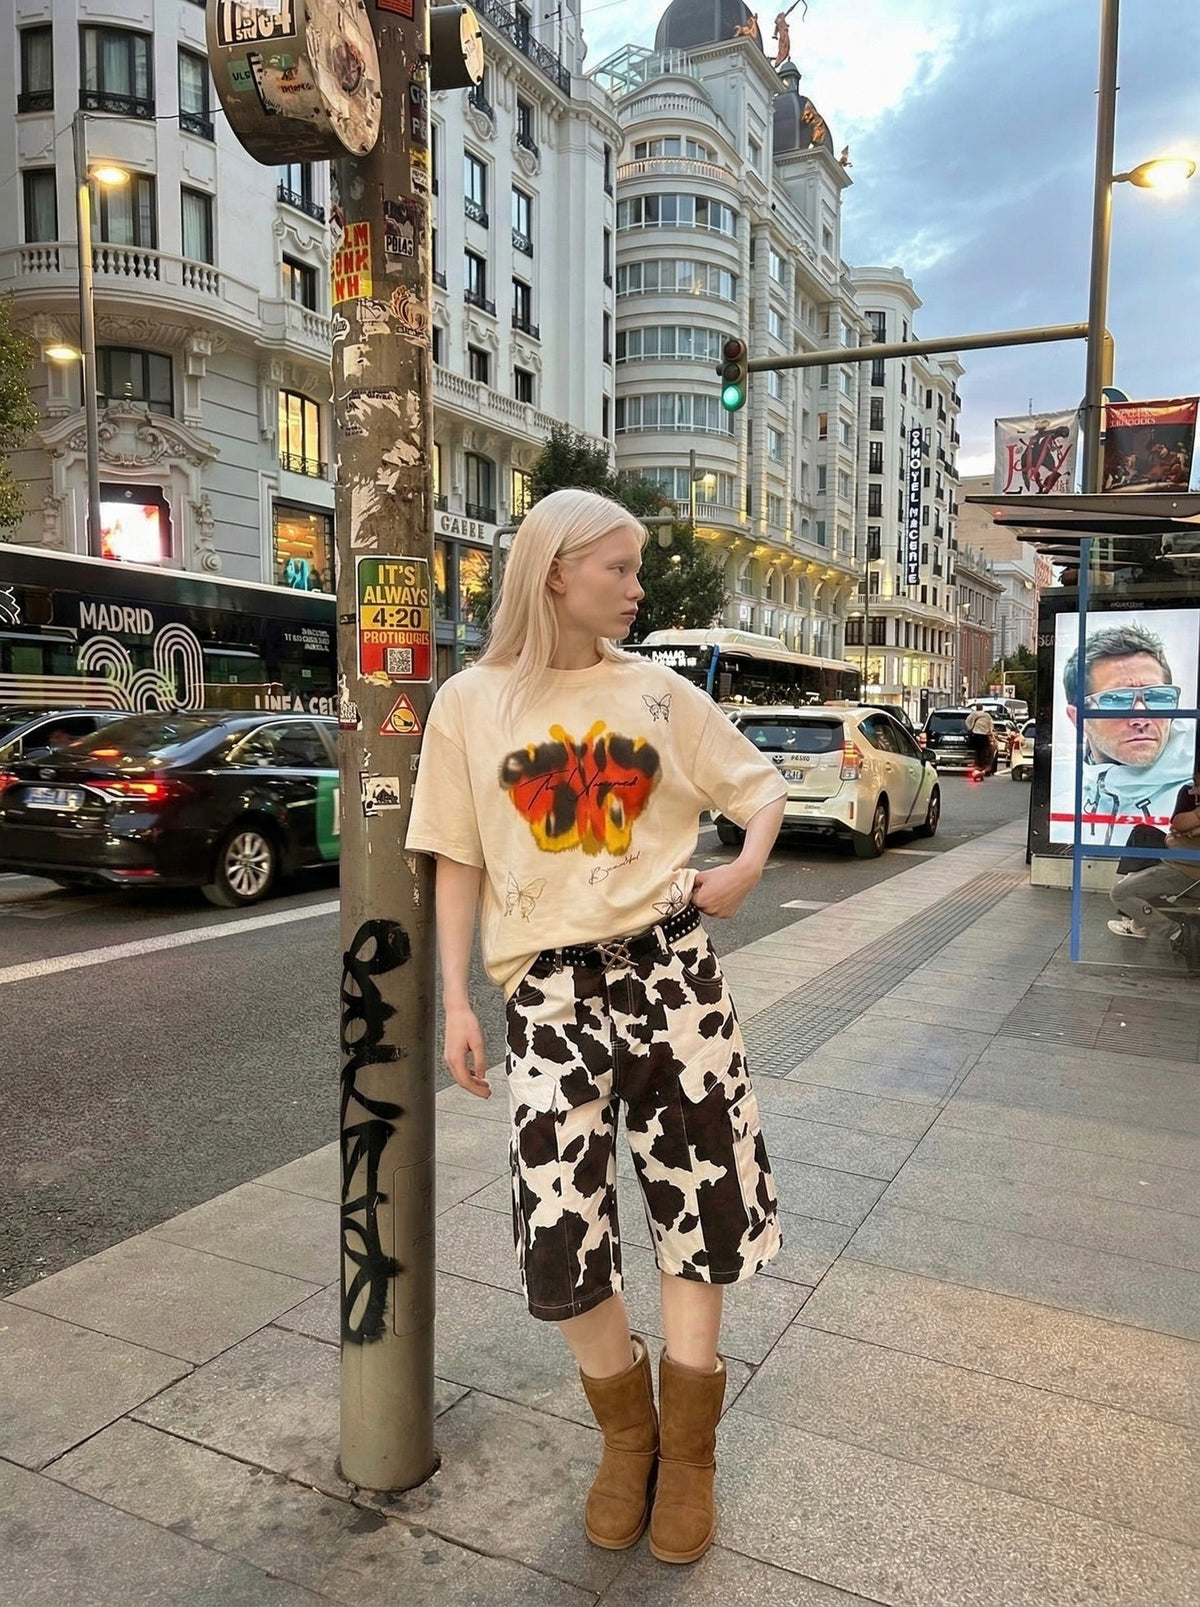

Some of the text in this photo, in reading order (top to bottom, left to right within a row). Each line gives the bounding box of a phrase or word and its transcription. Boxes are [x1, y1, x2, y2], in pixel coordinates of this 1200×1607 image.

[378, 564, 416, 586] IT'S
[363, 585, 428, 607] ALWAYS
[79, 600, 154, 635] MADRID
[372, 607, 422, 629] 4:20
